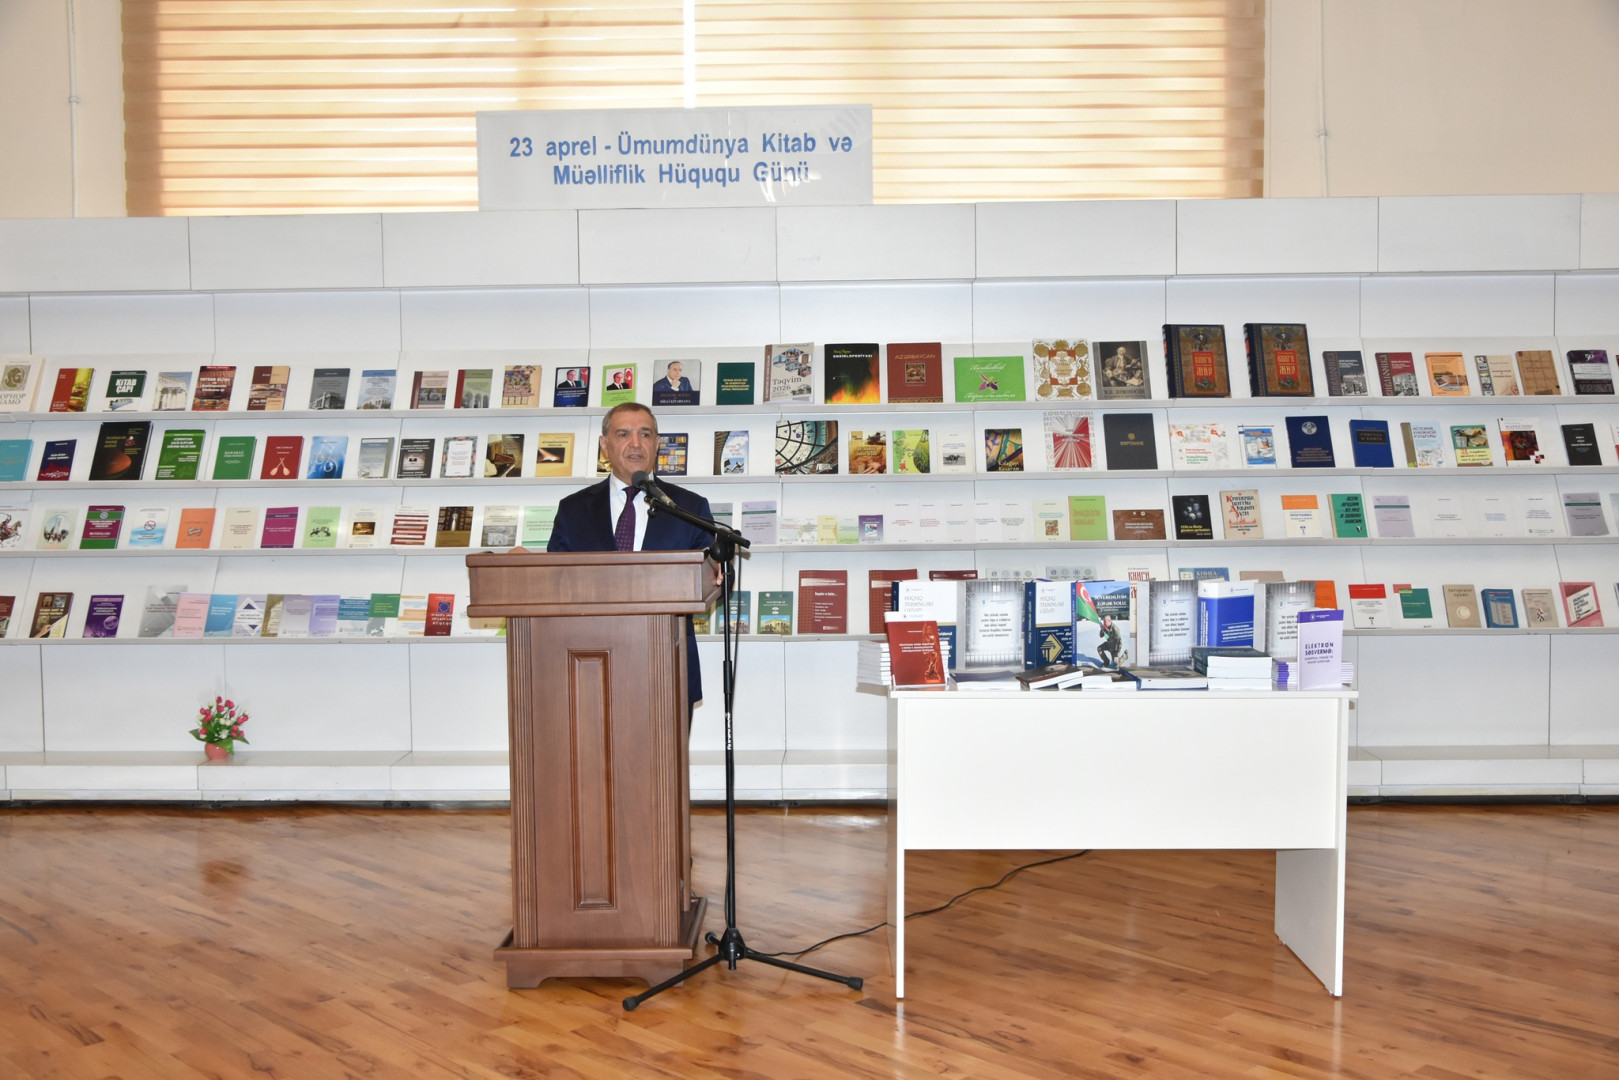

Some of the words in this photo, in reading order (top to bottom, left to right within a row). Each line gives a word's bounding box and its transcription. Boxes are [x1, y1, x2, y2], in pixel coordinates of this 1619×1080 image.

[509, 137, 533, 158] 23
[546, 136, 597, 161] aprel
[617, 131, 749, 159] Ümumdünya
[762, 132, 816, 154] Kitab
[828, 136, 853, 152] və
[553, 163, 646, 185] Müəlliflik
[659, 162, 740, 188] Hüququ
[753, 160, 809, 183] Günü
[115, 378, 137, 387] KİTAB
[772, 376, 802, 387] Təqvim
[115, 386, 134, 394] ÇAPI
[1304, 642, 1334, 650] ELEKTRON
